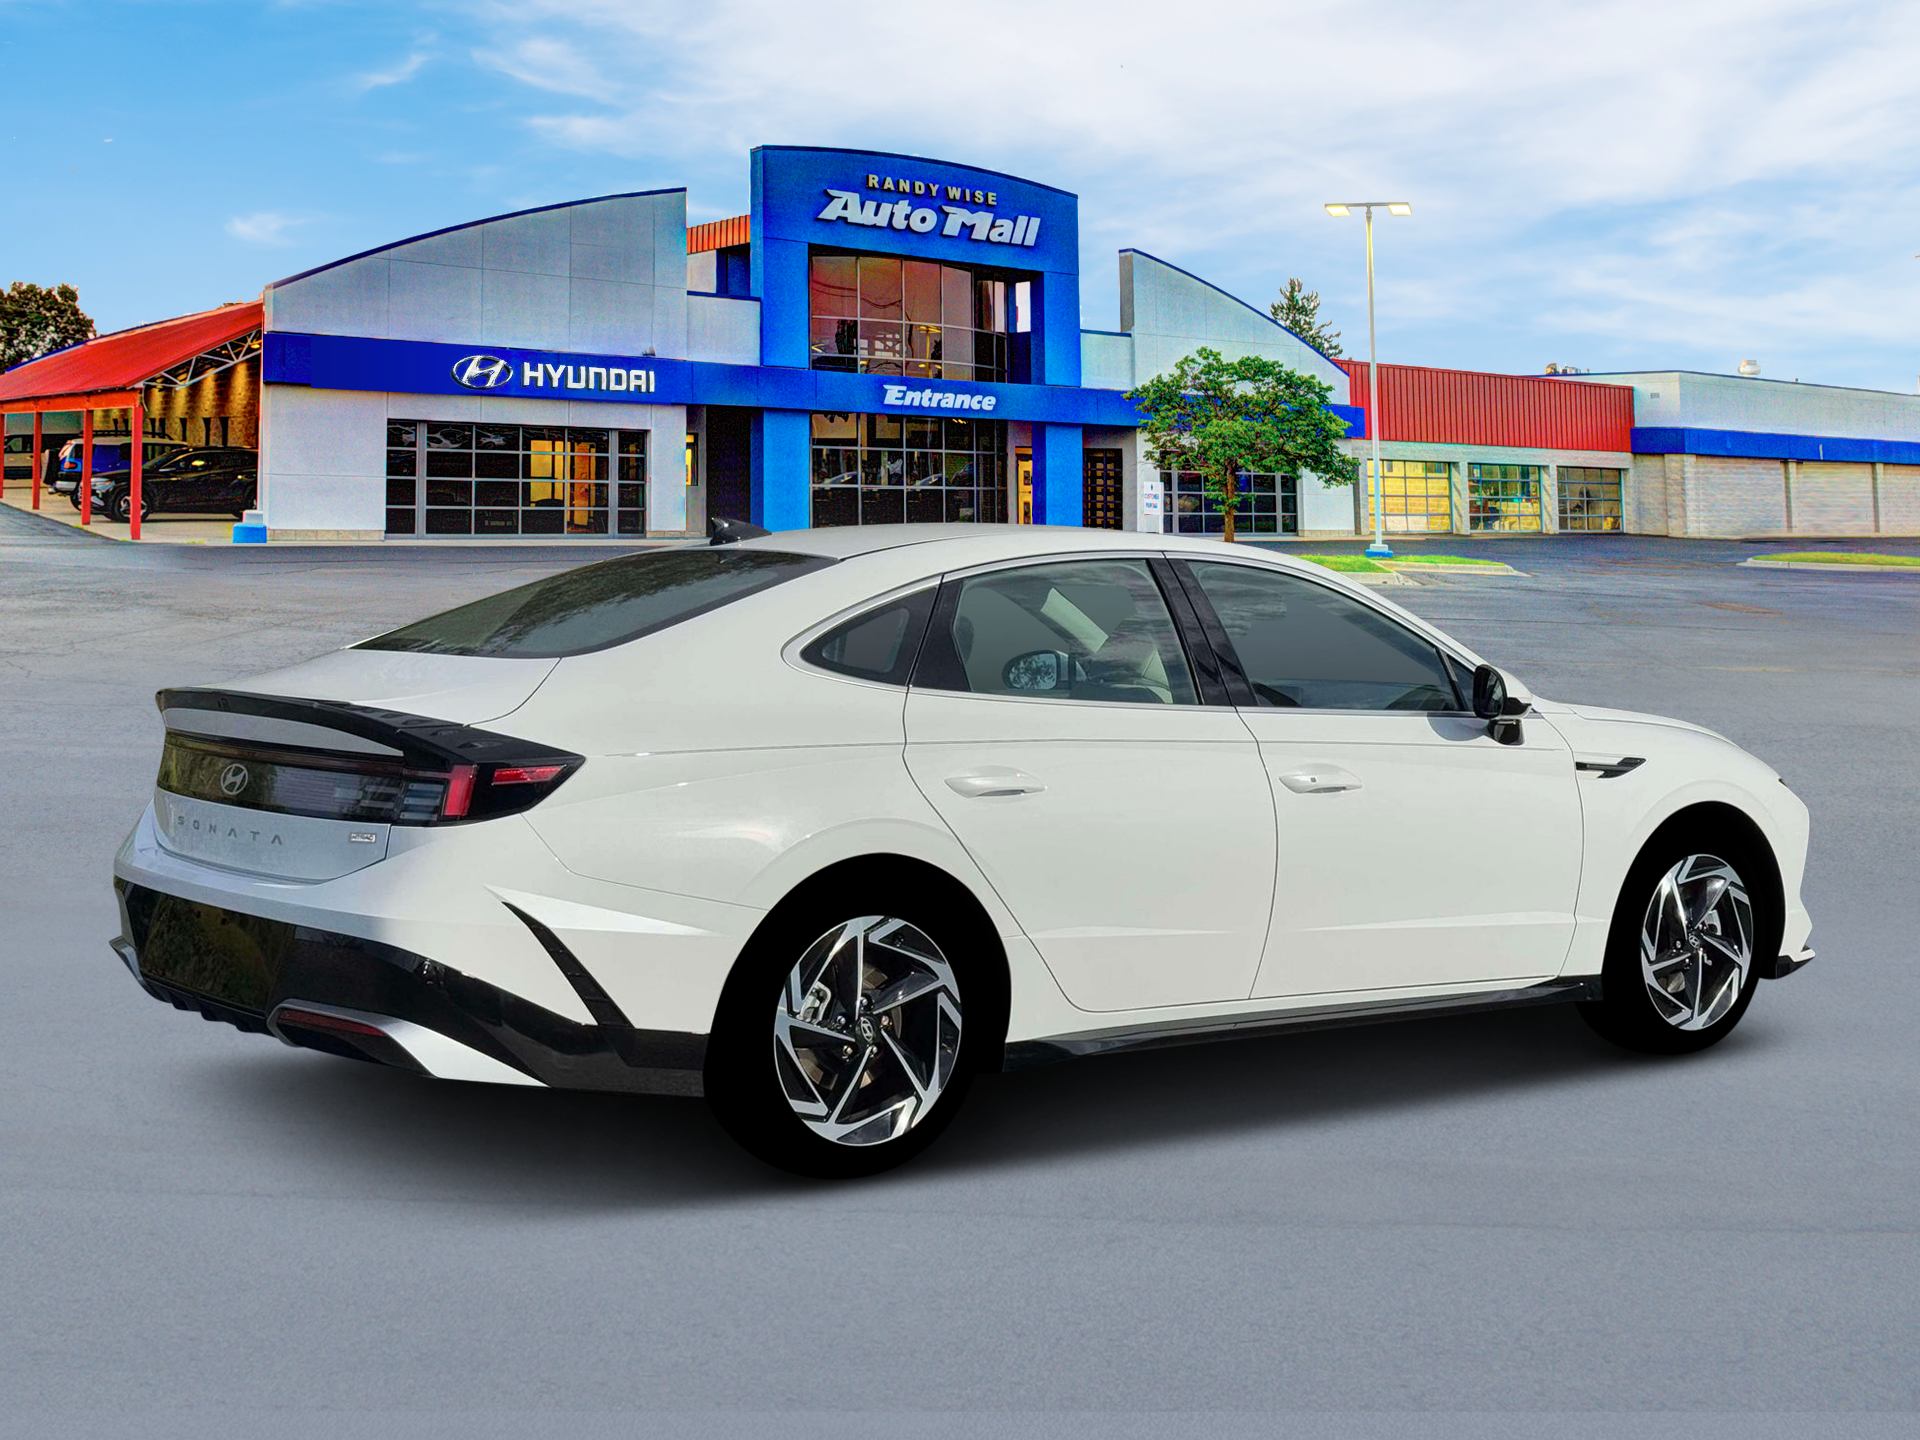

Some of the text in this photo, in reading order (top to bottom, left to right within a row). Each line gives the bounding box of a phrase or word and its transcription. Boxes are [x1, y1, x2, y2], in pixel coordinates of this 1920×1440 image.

[867, 174, 997, 205] RANDY WISE
[818, 189, 1041, 247] Auto Mall
[523, 361, 655, 392] HYUNDAI
[883, 384, 996, 411] Entrance
[177, 815, 283, 846] SONATA
